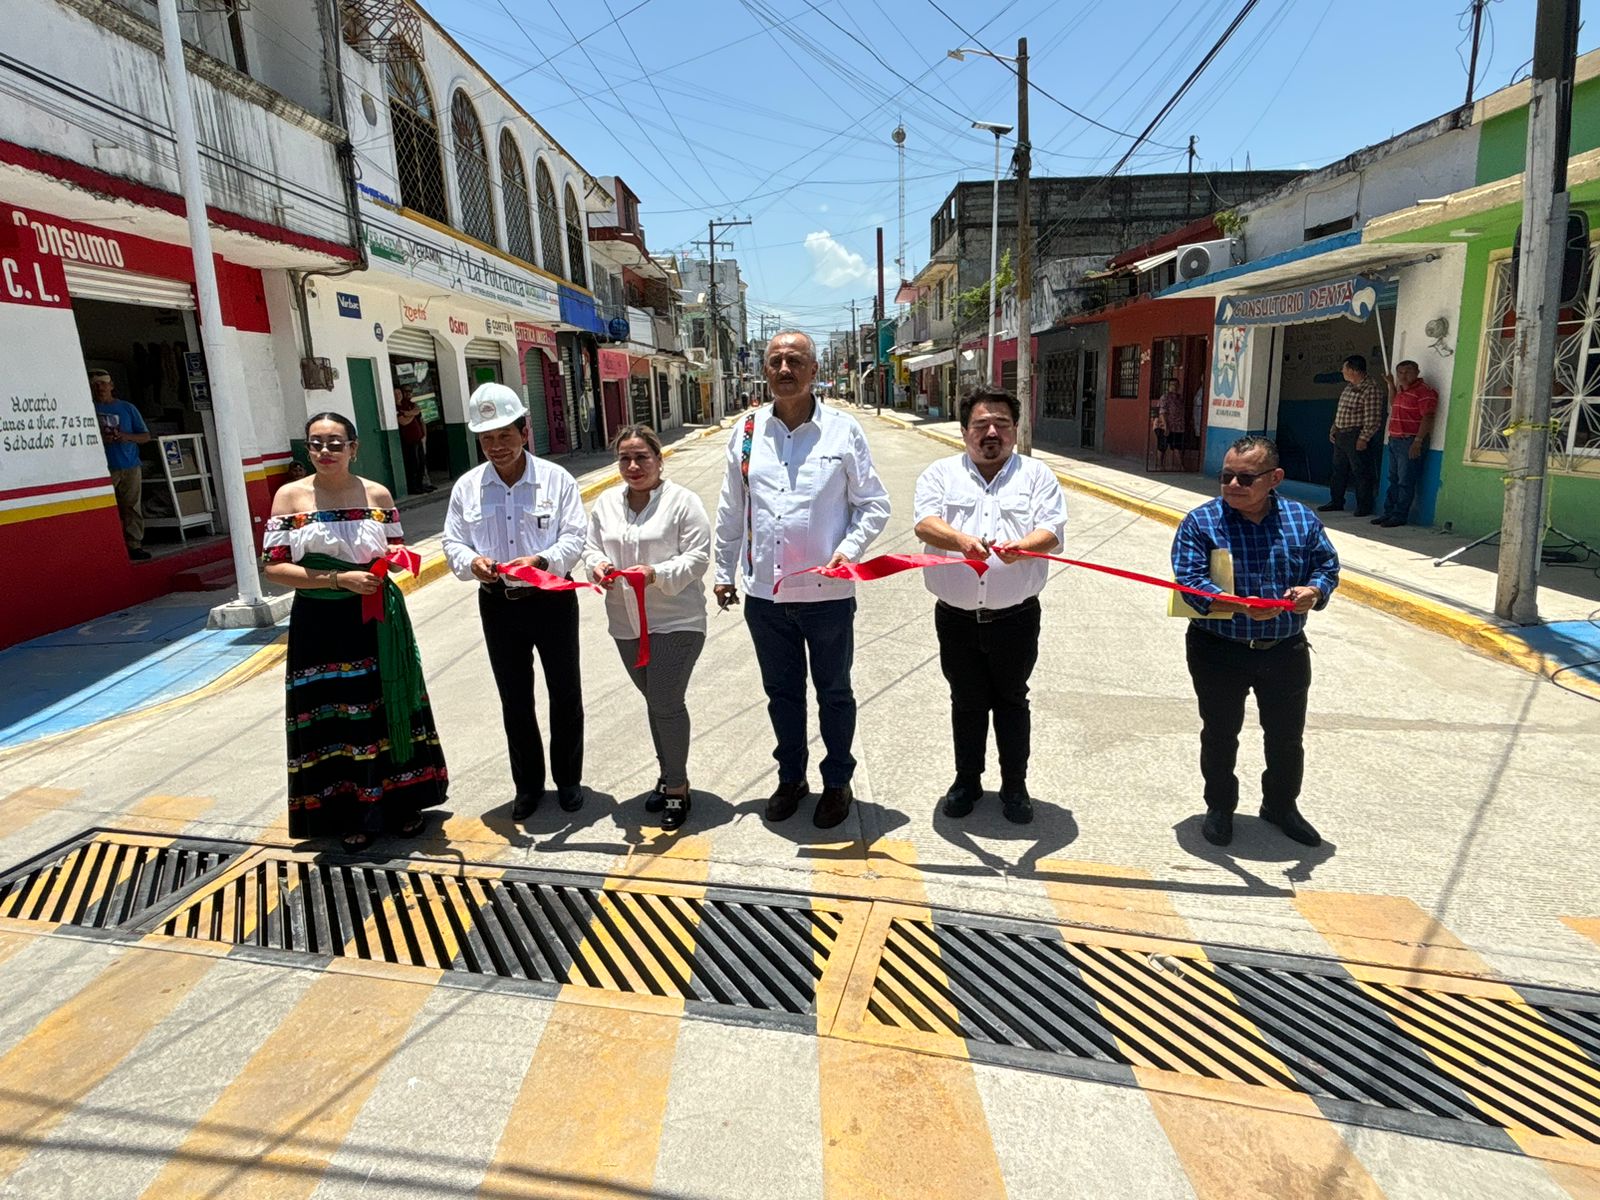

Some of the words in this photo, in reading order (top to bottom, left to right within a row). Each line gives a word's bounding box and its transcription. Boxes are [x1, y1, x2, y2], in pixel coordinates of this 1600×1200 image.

[465, 250, 482, 282] La
[482, 257, 526, 297] Potranca
[338, 295, 360, 310] Virbac
[1232, 291, 1304, 318] CONSULTORIO
[1308, 279, 1357, 311] DENTA
[491, 319, 513, 334] CORTEVA
[11, 393, 57, 412] Horario
[28, 418, 34, 430] a
[4, 432, 55, 452] Sábados
